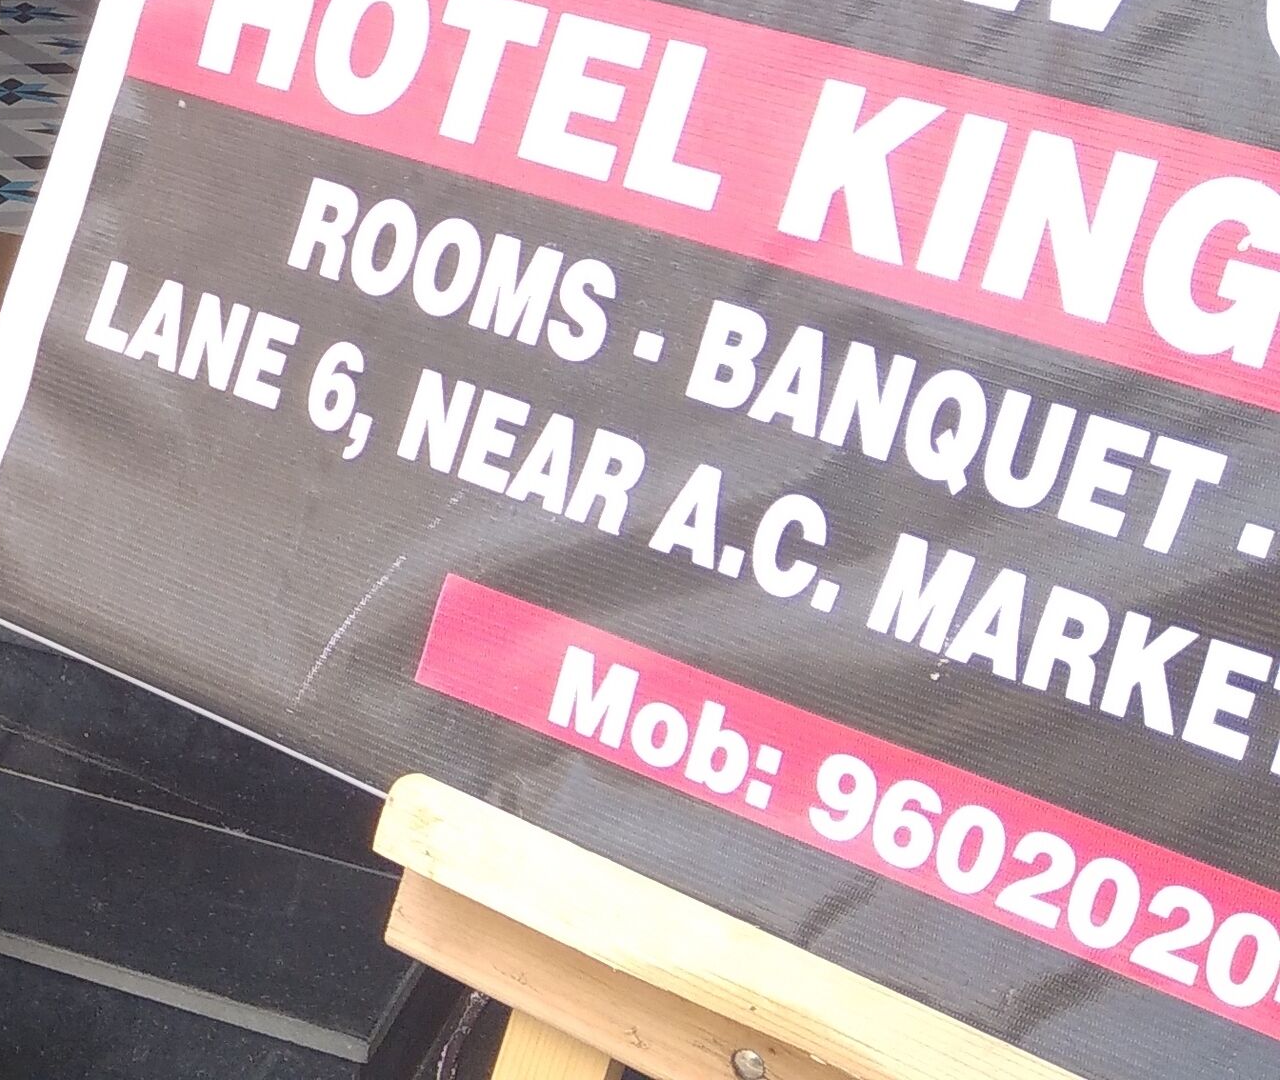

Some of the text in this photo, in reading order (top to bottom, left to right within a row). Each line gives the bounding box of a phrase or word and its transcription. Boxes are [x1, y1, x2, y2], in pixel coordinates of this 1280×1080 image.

[288, 178, 617, 362] ROOMS
[685, 299, 1228, 554] BANQUET
[778, 79, 1280, 369] KING
[85, 261, 1280, 772] LANE 6, NEAR A.C. MARKE
[548, 645, 1280, 1008] Mob: 9602020
